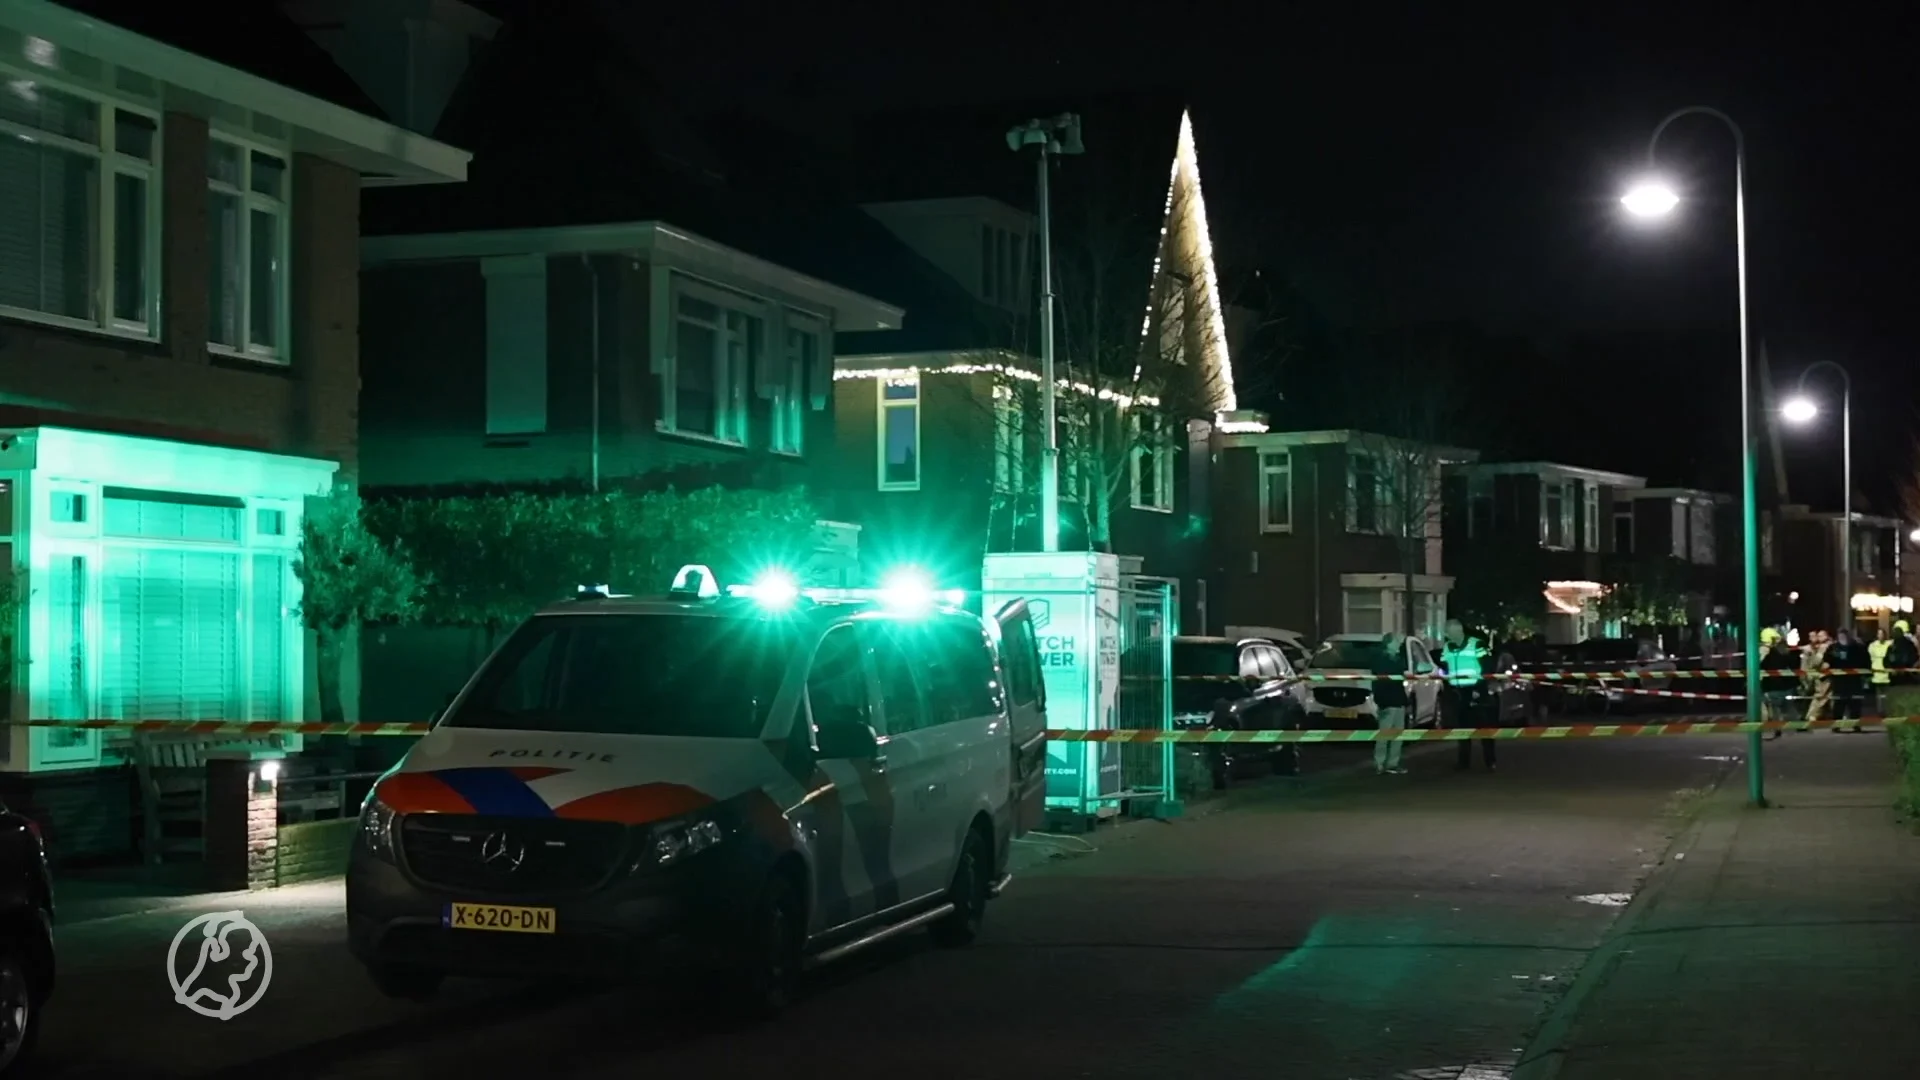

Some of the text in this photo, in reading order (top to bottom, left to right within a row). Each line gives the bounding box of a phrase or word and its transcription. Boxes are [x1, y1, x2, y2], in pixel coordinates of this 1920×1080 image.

[1036, 636, 1074, 650] TCH
[489, 750, 616, 763] POLITIE
[455, 906, 549, 929] X-620-DN
